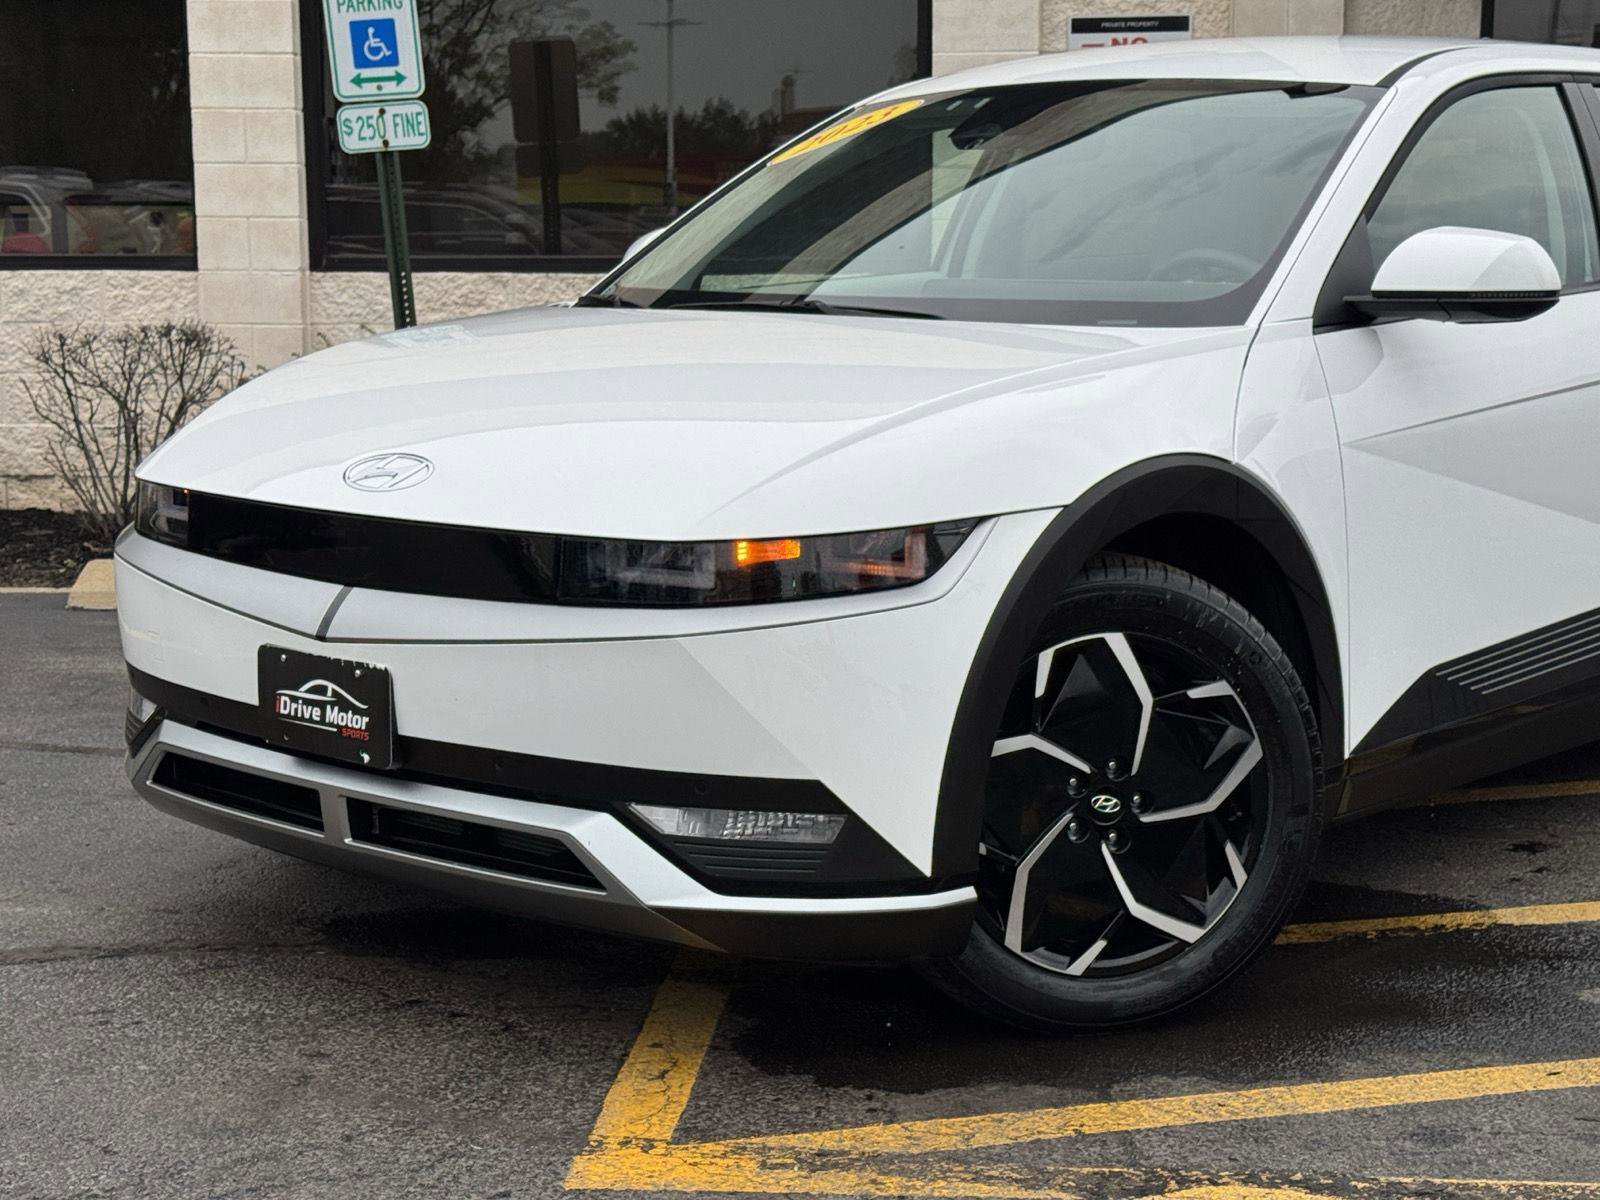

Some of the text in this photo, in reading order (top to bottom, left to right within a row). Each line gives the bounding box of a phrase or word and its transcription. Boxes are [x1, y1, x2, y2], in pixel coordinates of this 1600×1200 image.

[336, 0, 403, 13] PARKING
[392, 111, 426, 138] FINE
[275, 695, 370, 730] iDrive Motor
[341, 728, 369, 741] SPORTS
